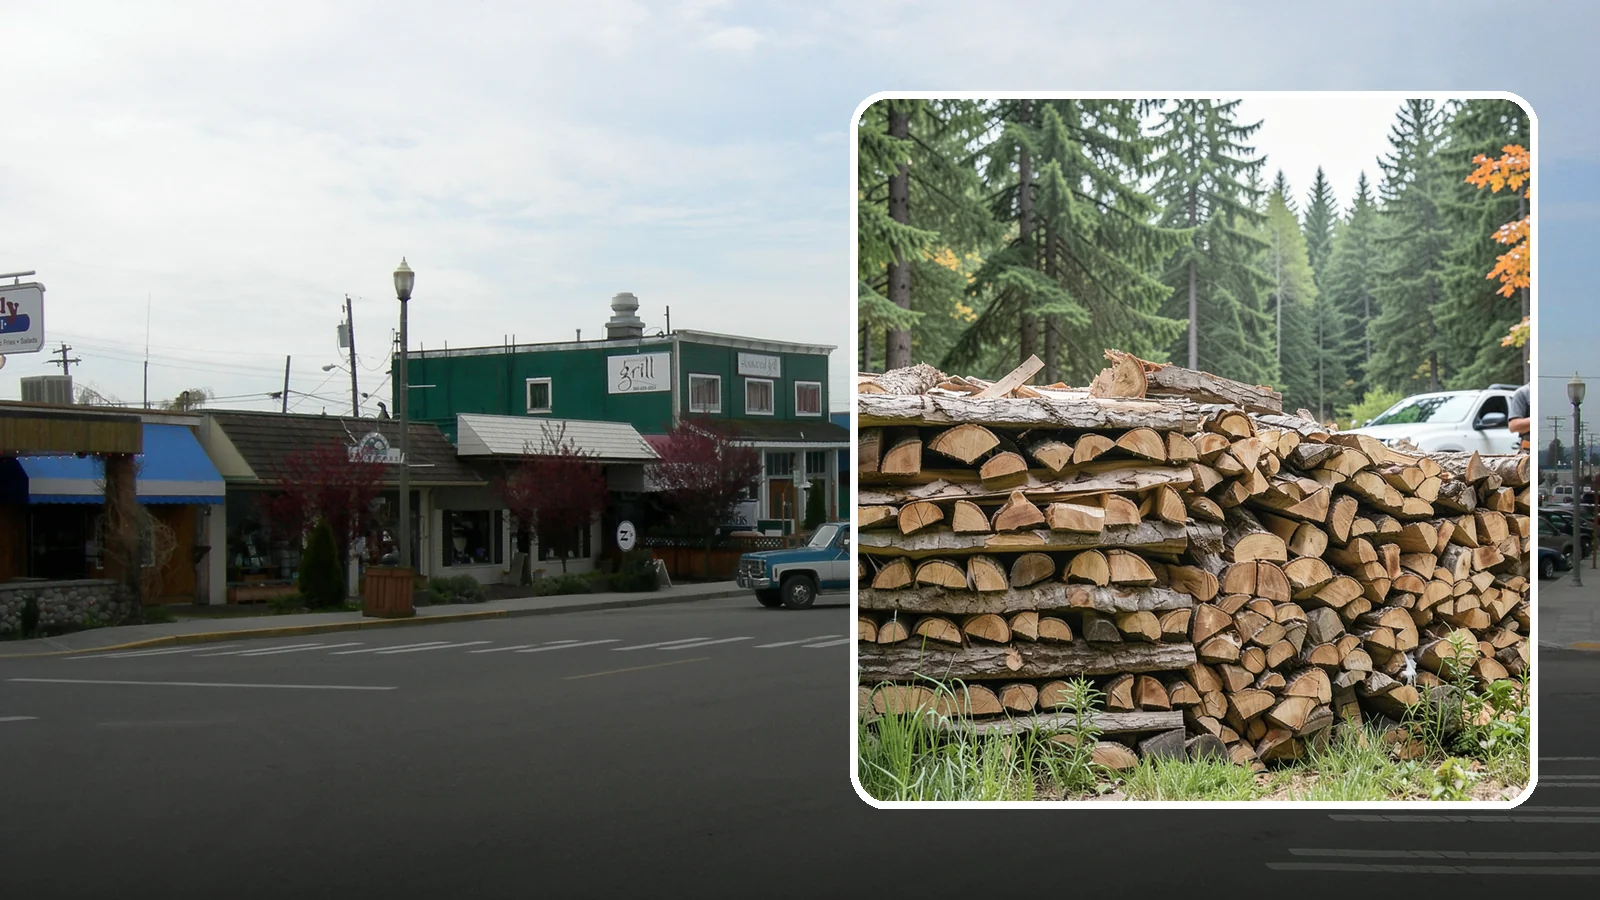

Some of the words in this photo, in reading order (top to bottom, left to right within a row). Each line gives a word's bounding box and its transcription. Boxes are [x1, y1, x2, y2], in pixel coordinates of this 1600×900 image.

[3, 338, 16, 346] Fries
[20, 337, 38, 345] Salads
[618, 356, 655, 391] grill
